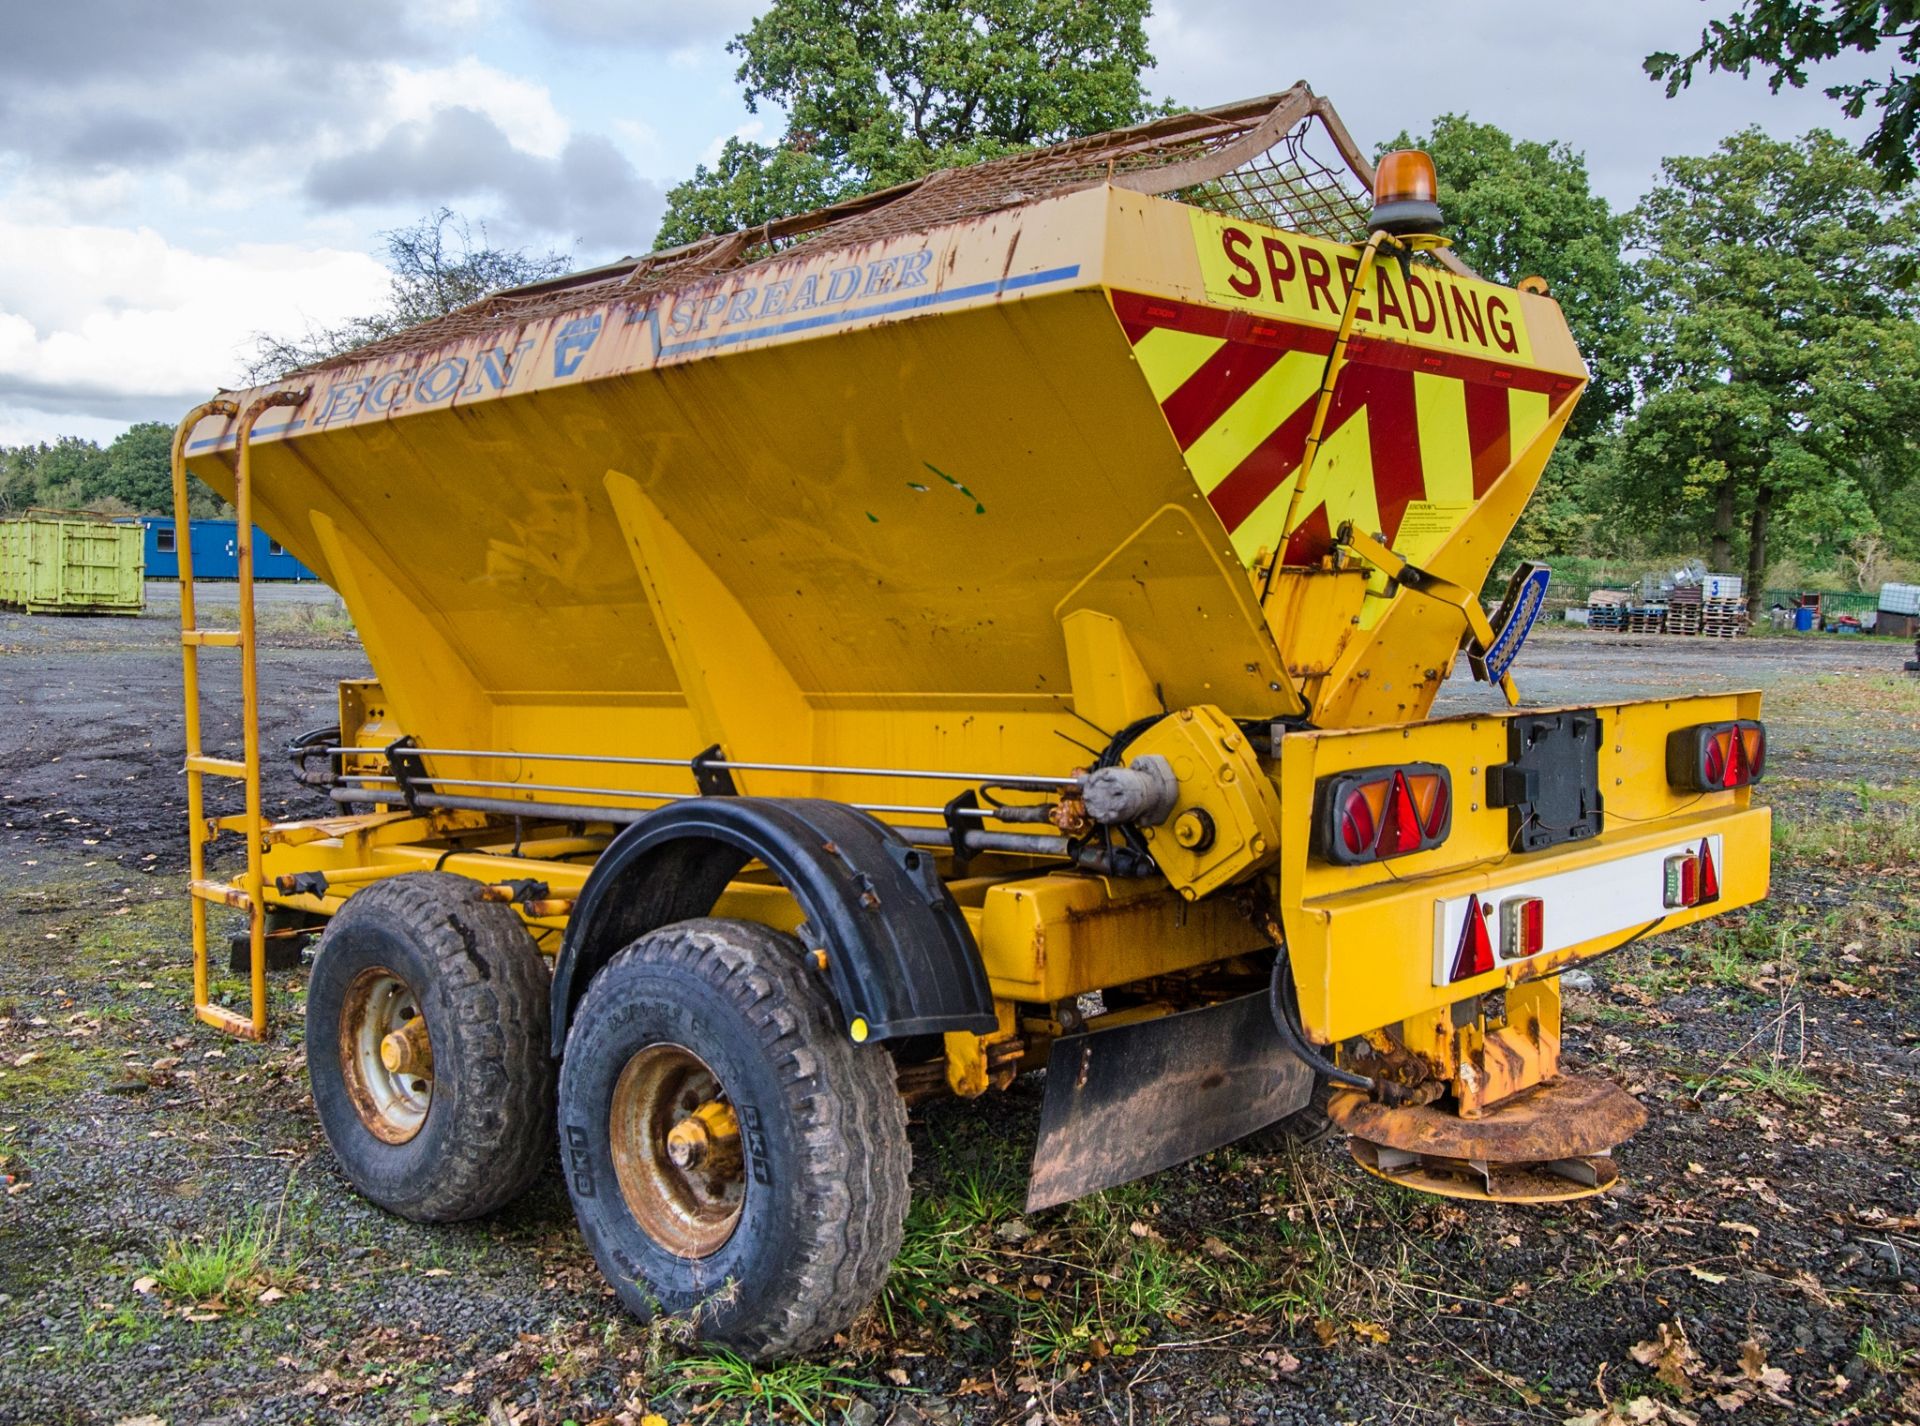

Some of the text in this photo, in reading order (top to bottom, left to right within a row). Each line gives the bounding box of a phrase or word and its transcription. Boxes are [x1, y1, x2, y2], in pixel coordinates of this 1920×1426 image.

[666, 249, 933, 337] SPREADER
[1222, 227, 1519, 353] SPREADING
[313, 339, 535, 425] ECON
[1711, 580, 1719, 596] 3
[567, 1125, 597, 1198] BKT
[742, 1105, 773, 1186] BKT
